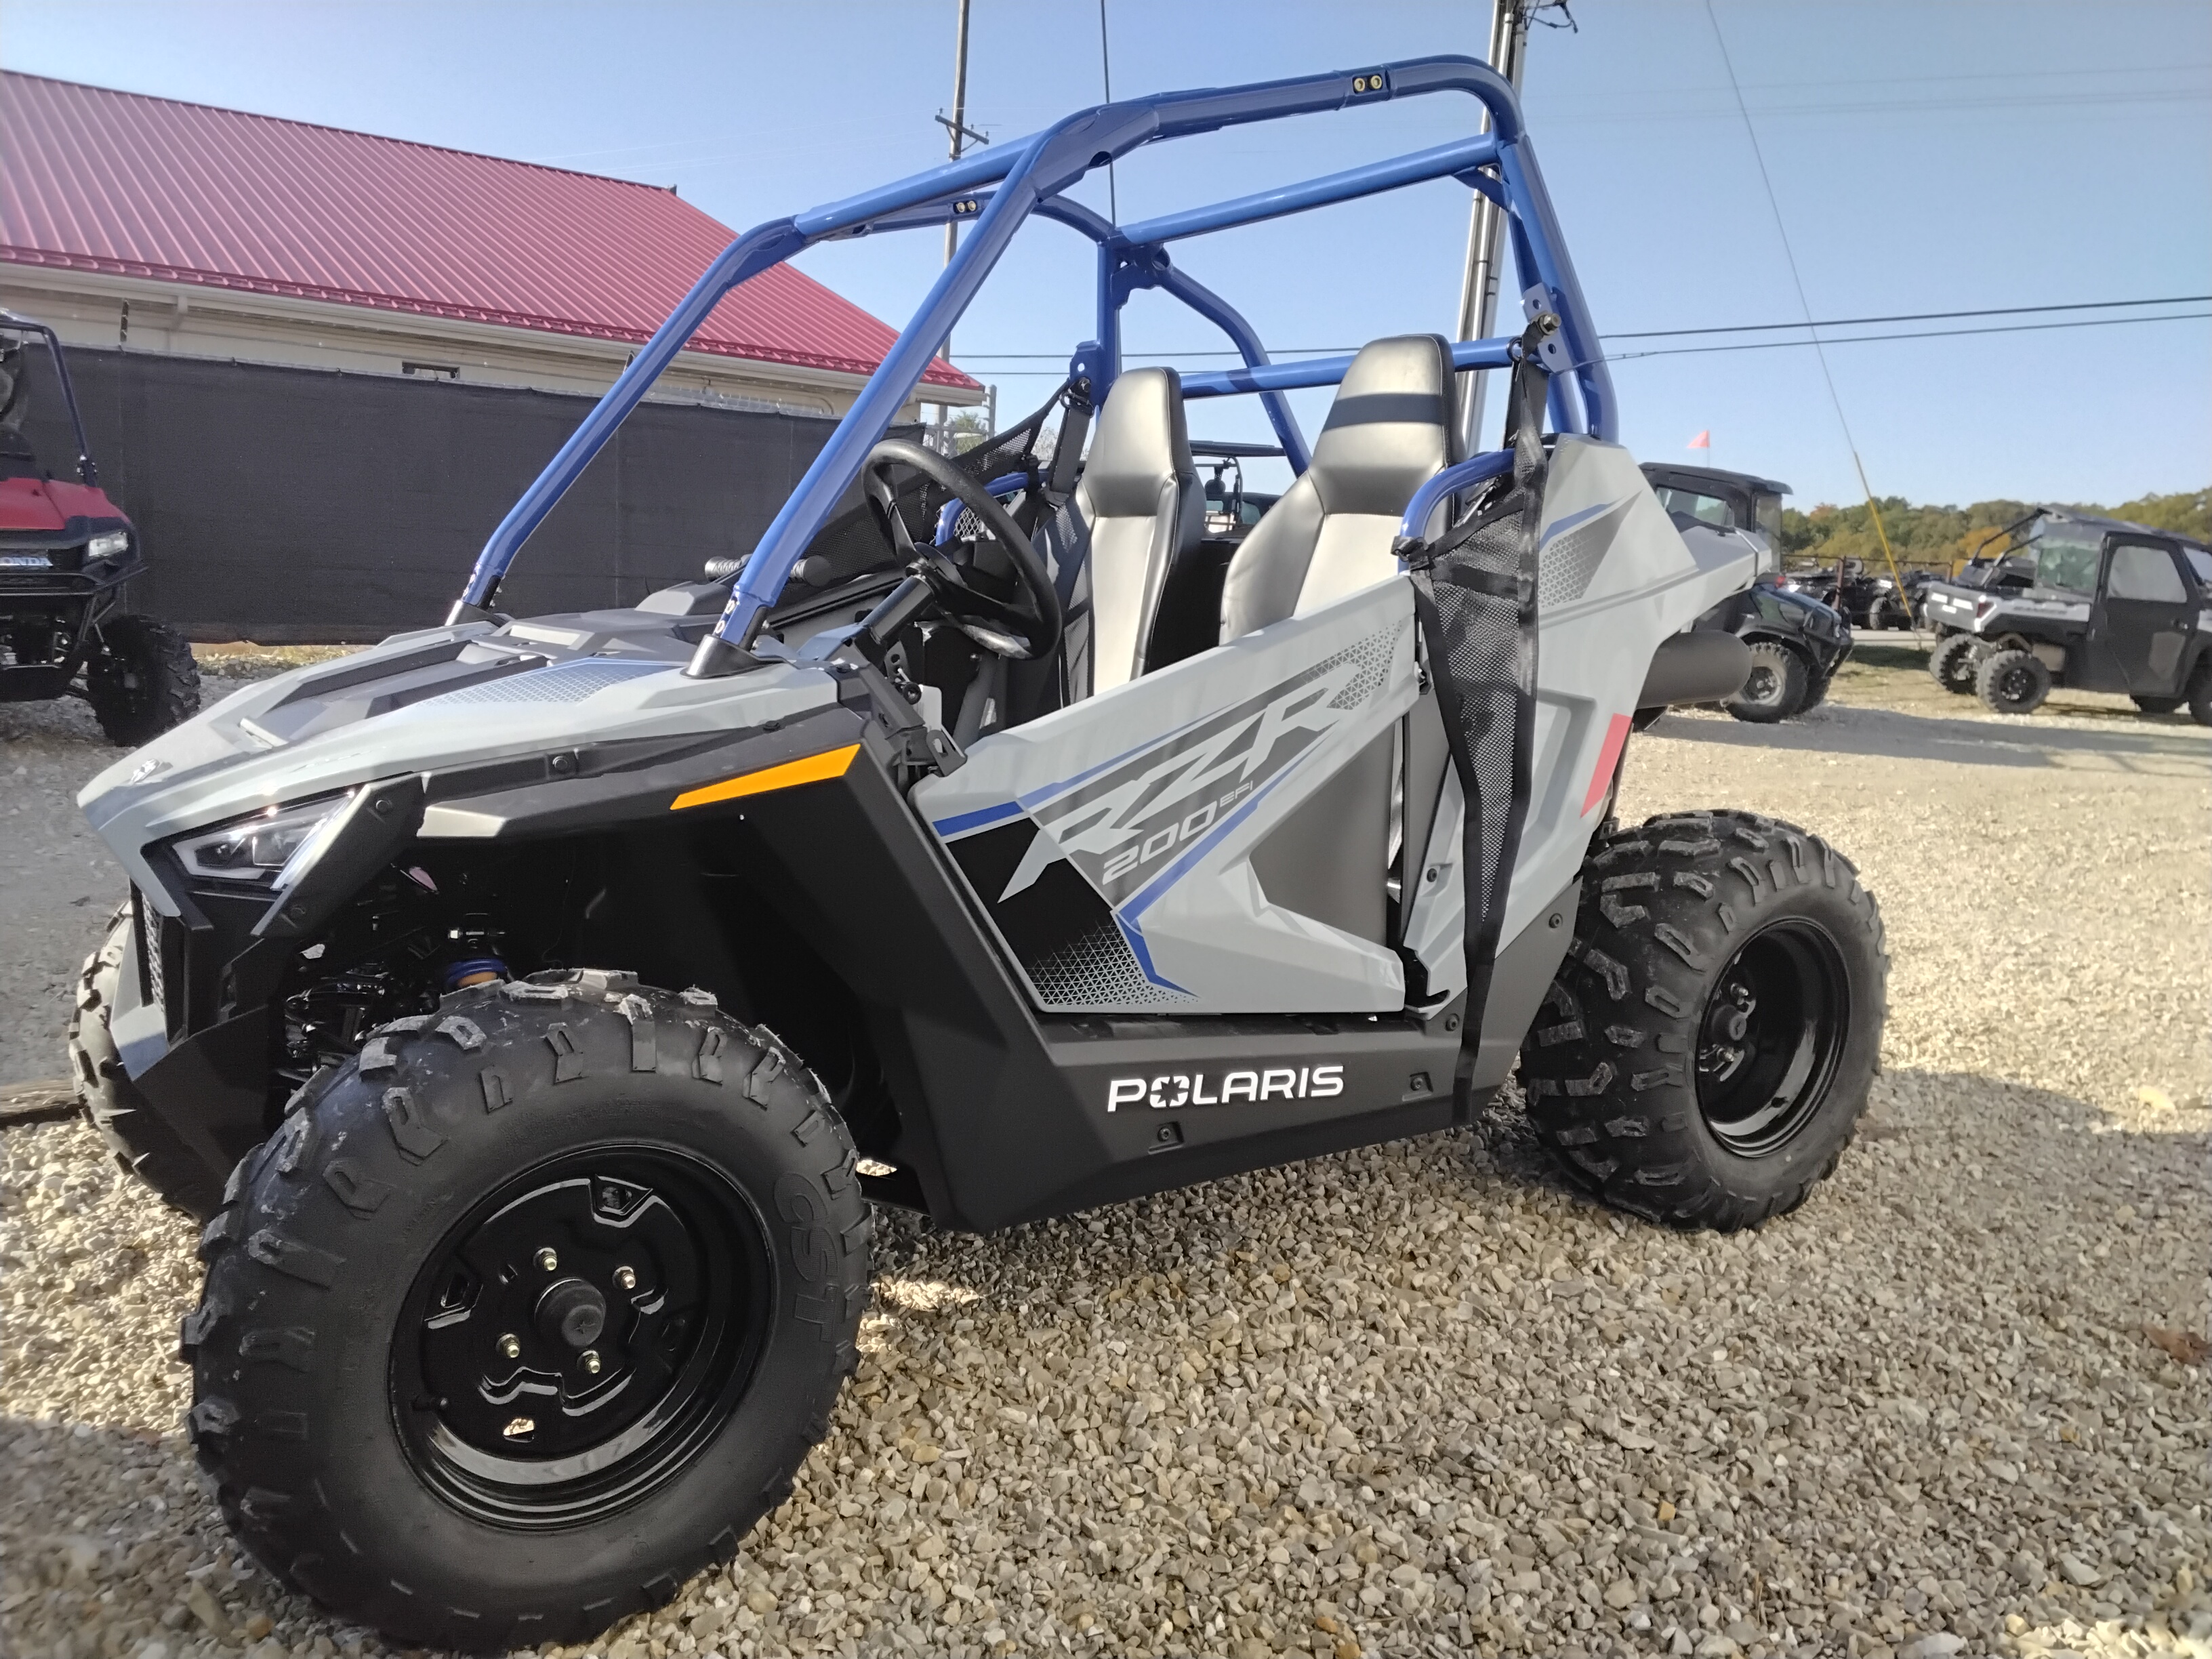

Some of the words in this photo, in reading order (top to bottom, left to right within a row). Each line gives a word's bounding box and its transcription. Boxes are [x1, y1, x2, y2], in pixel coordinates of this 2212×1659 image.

[0, 556, 53, 566] ONDA
[998, 661, 1364, 903] RZR
[1102, 800, 1217, 886] 200
[1219, 780, 1254, 808] EFI
[1107, 1065, 1345, 1112] POLARIS
[773, 1173, 840, 1343] CST
